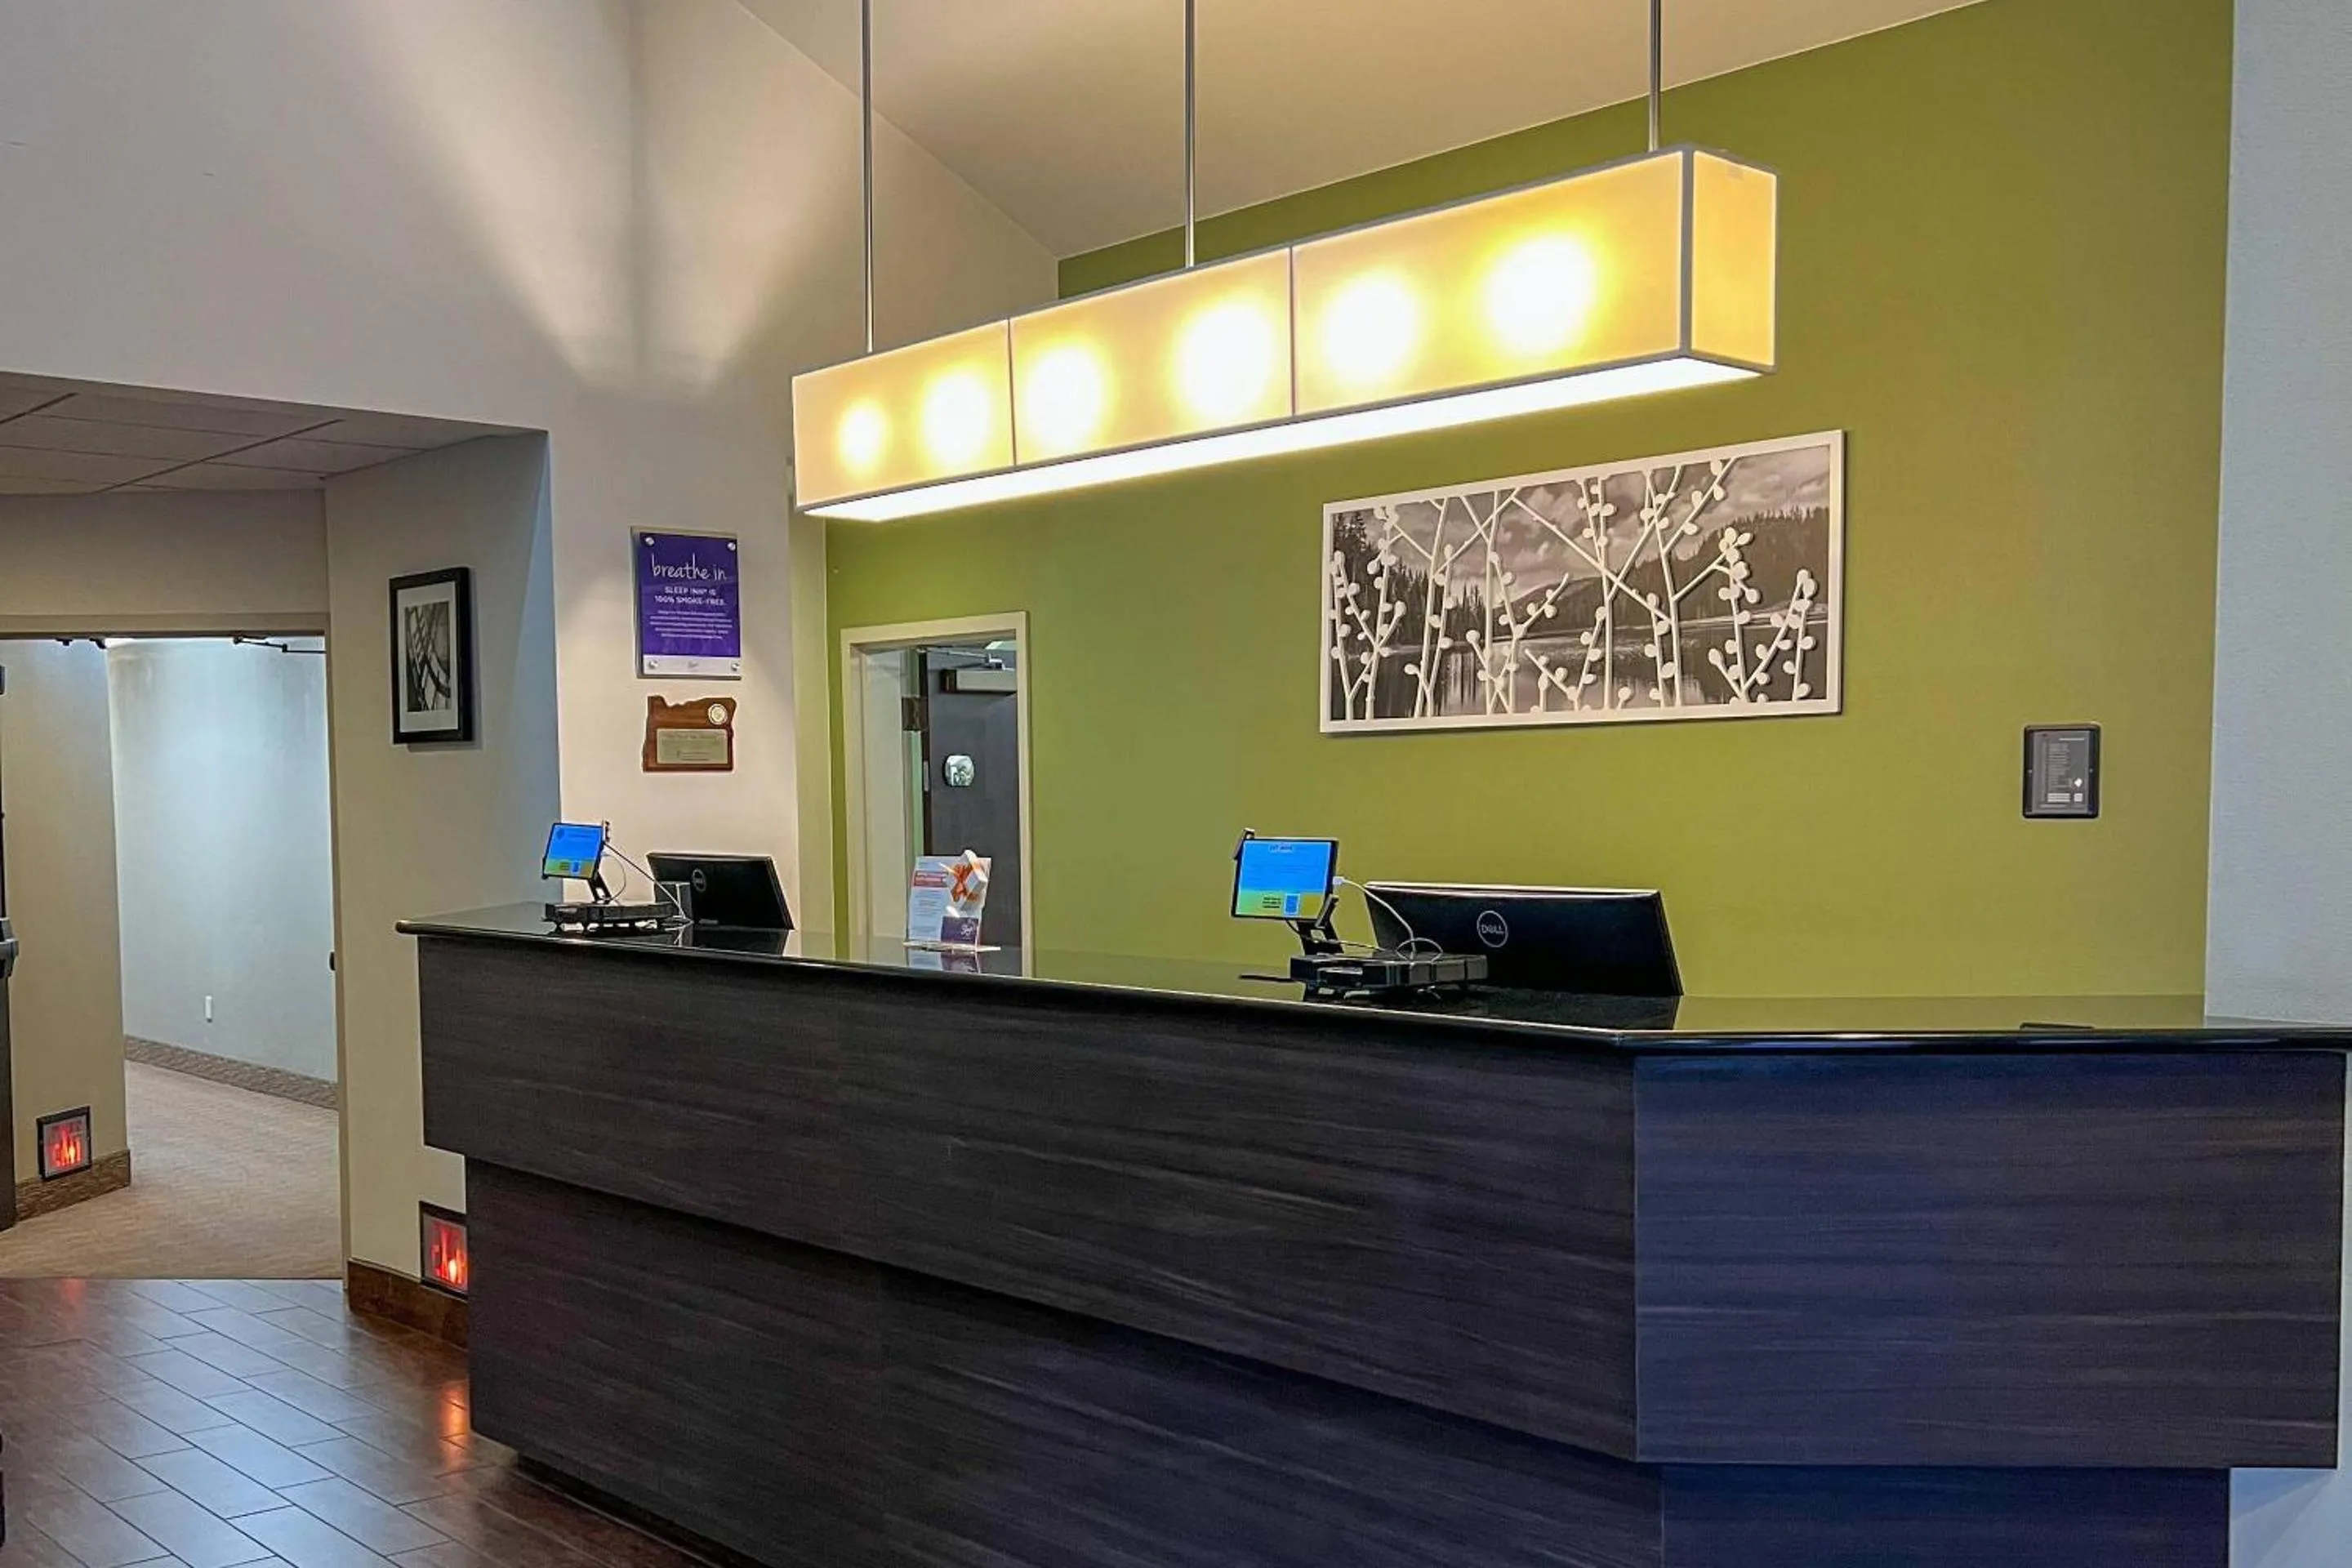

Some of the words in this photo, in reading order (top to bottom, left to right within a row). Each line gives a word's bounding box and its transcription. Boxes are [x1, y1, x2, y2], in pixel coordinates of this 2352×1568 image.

[651, 552, 710, 580] breathe
[713, 564, 728, 581] in
[1481, 924, 1504, 934] DELL
